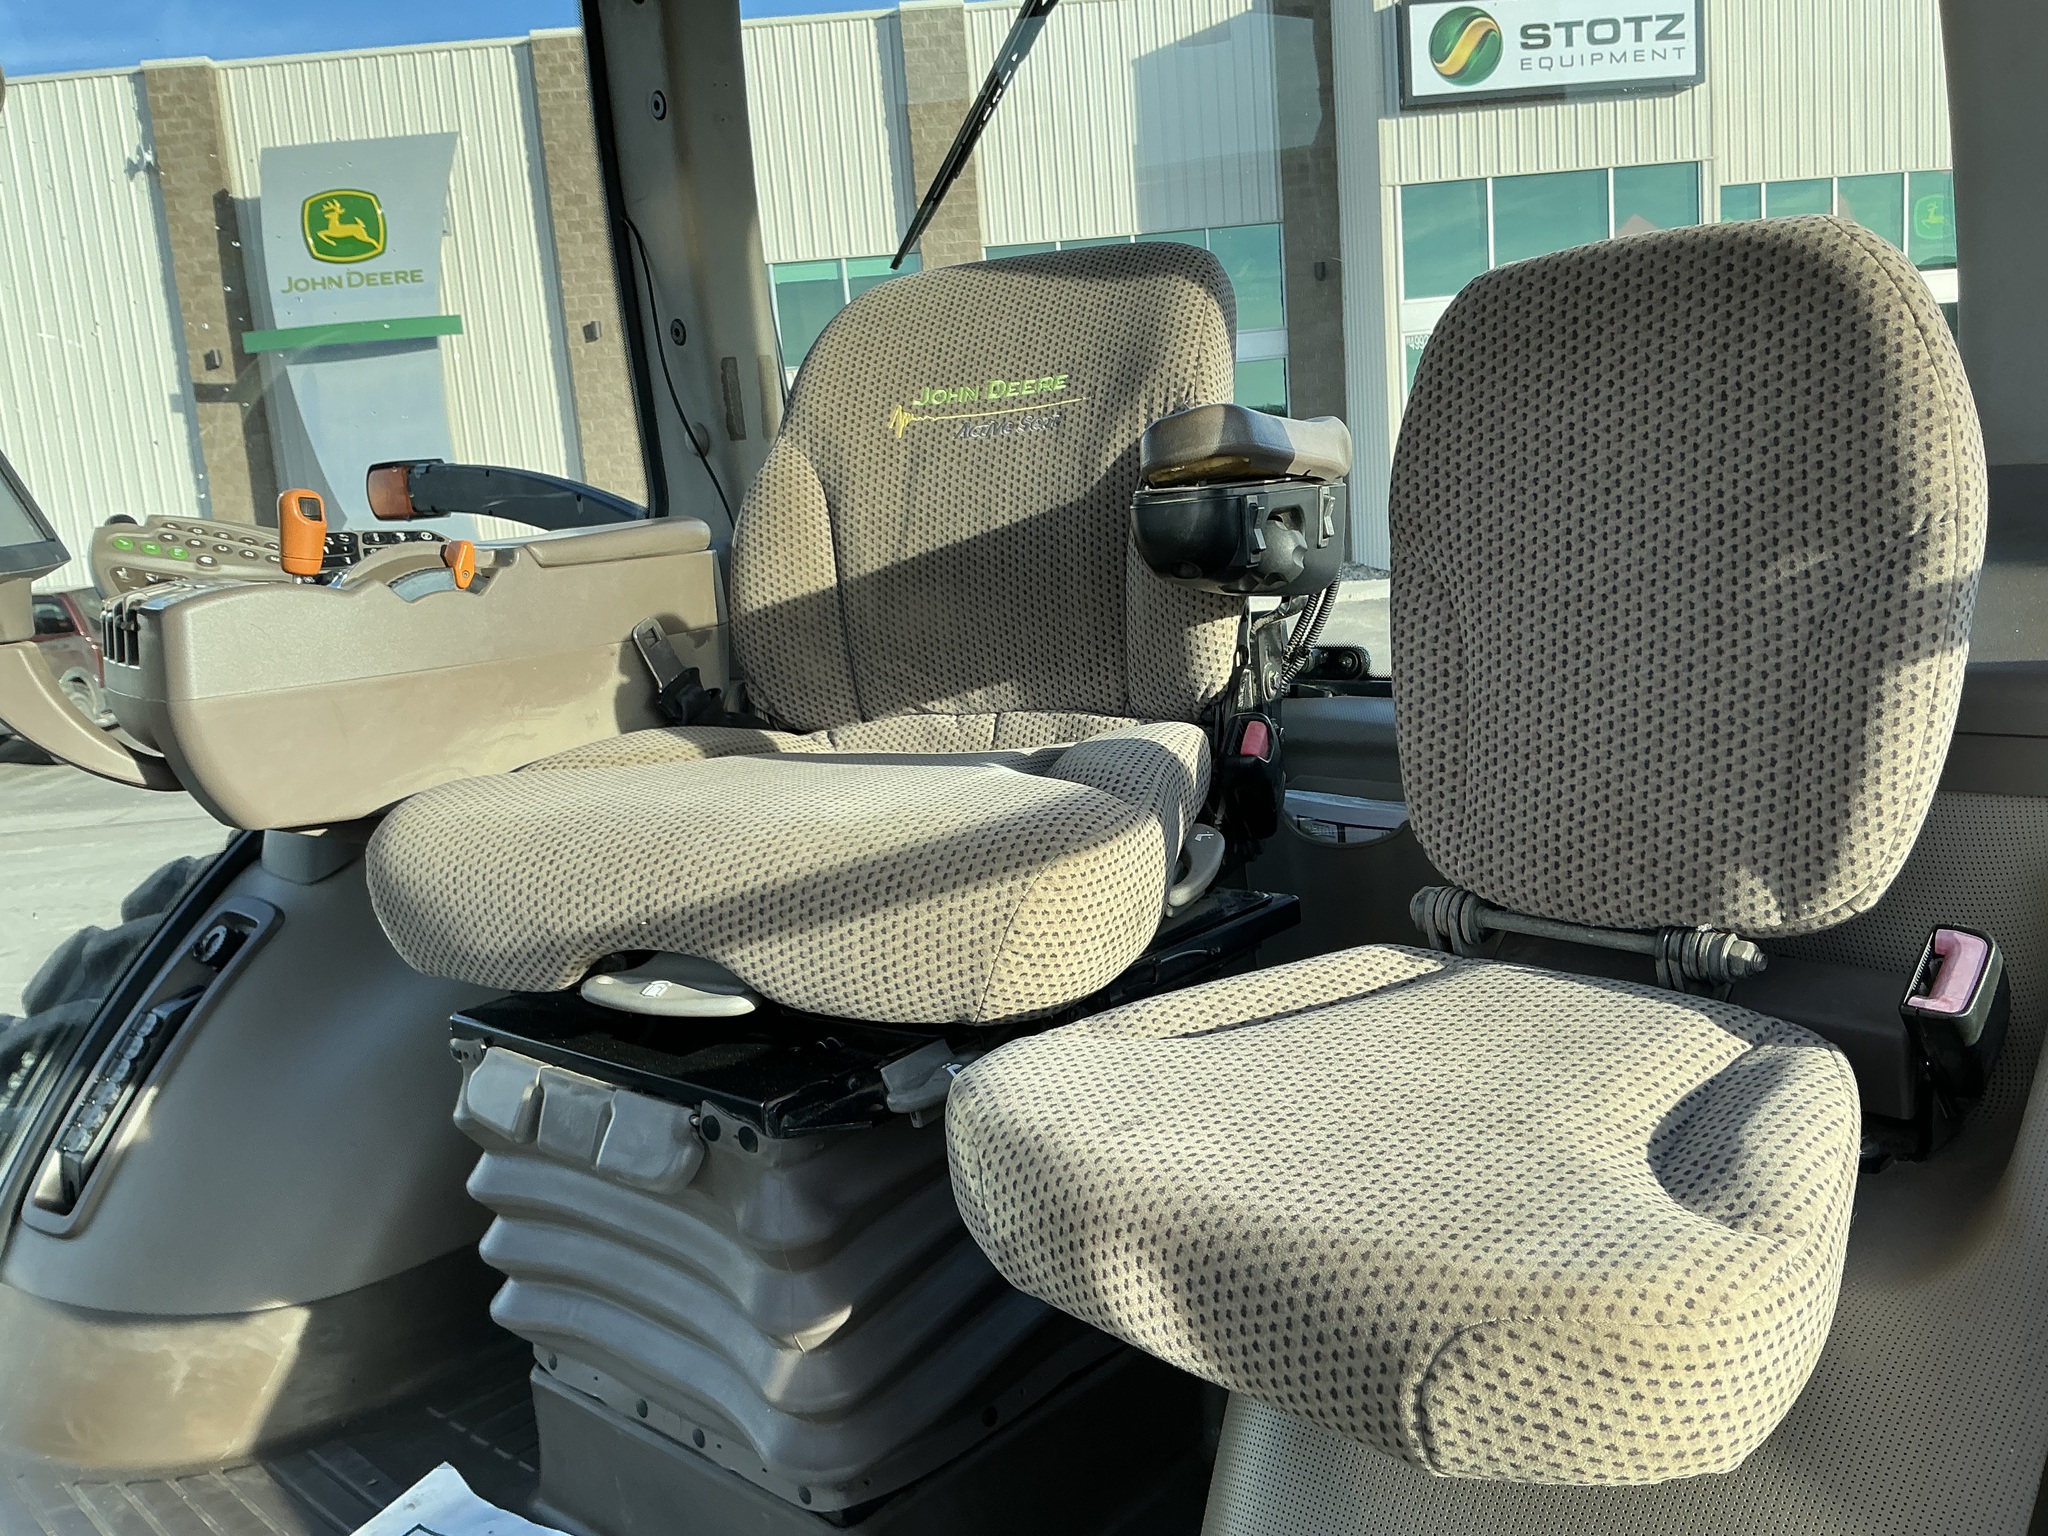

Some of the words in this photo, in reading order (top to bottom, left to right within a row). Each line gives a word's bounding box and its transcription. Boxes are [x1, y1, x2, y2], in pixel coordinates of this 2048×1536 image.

[1519, 13, 1686, 50] STOTZ
[1520, 47, 1686, 71] EQUIPMENT
[281, 275, 344, 294] JOHN
[346, 269, 424, 289] DEERE
[912, 384, 980, 406] JOHN
[986, 374, 1069, 400] DEERE
